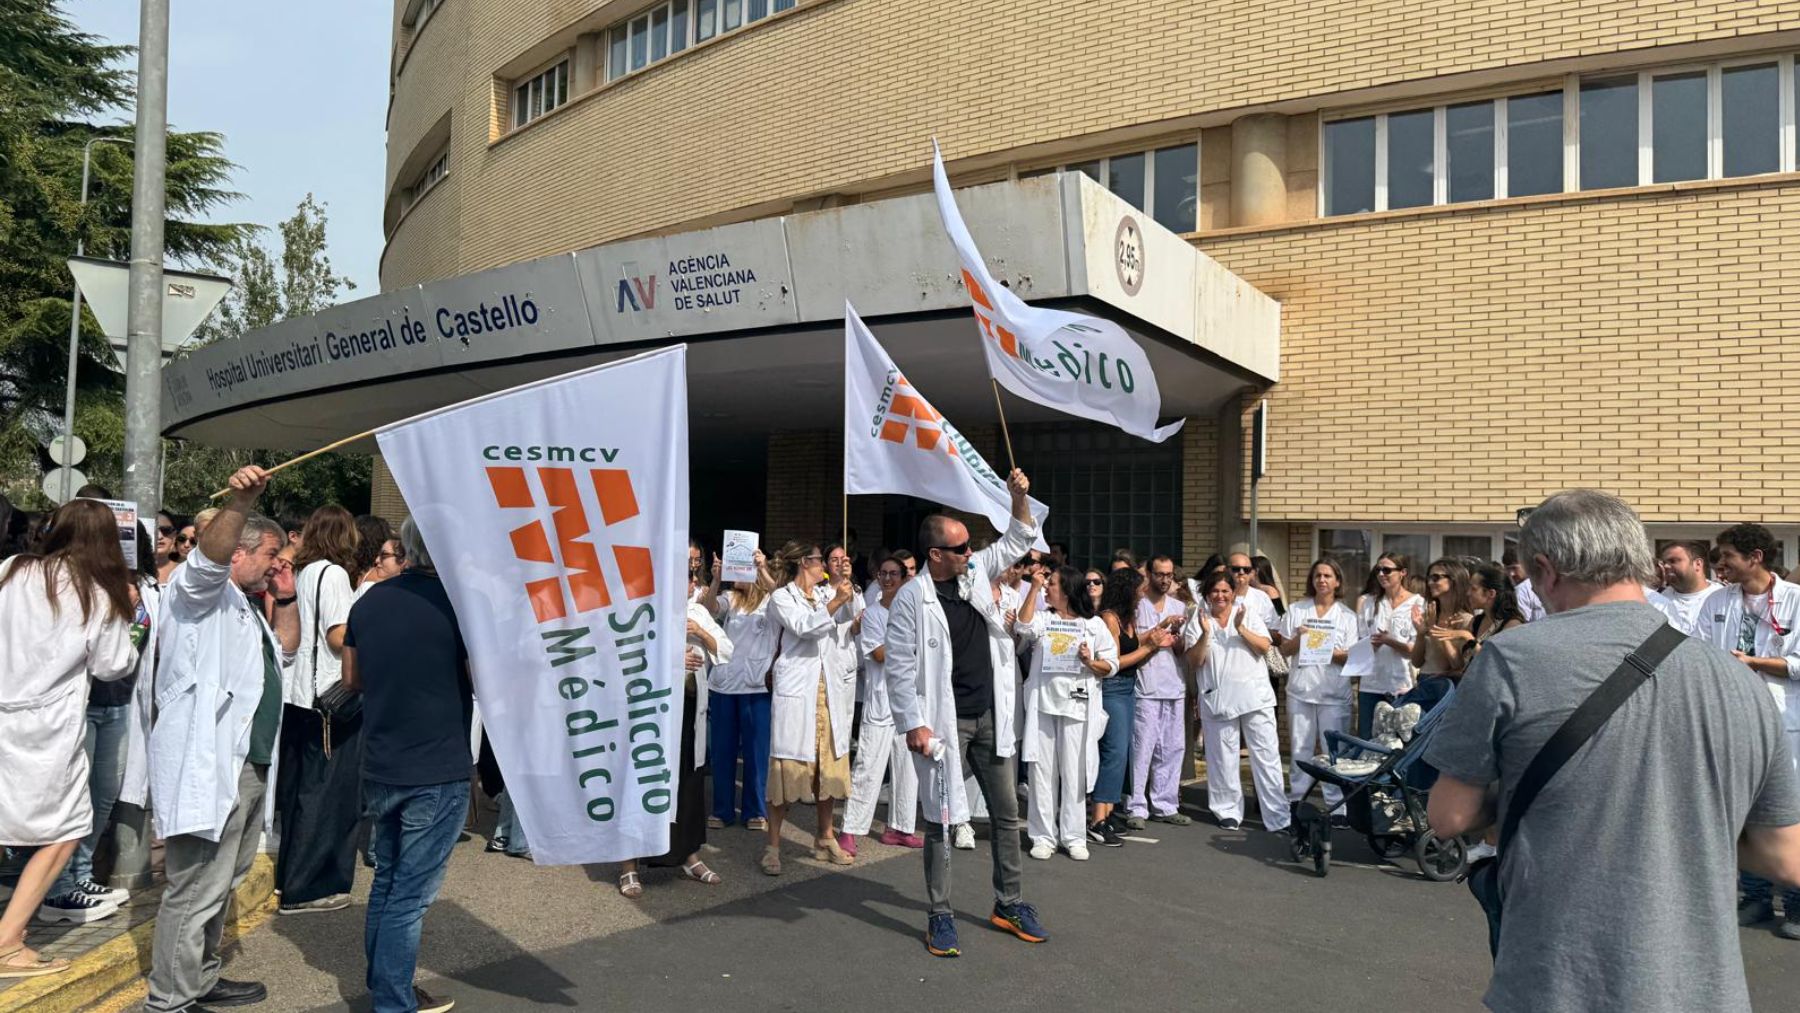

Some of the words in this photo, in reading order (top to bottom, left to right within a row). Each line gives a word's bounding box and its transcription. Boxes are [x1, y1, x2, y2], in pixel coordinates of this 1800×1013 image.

[670, 269, 757, 293] VALENCIANA
[674, 296, 694, 311] DE
[697, 289, 741, 309] SALUT
[206, 358, 249, 391] Hospital
[250, 336, 323, 380] Universitari
[325, 319, 397, 361] General
[400, 314, 427, 346] de
[482, 444, 620, 463] cesmcv
[540, 626, 620, 822] Médico
[607, 602, 673, 815] Sindicato
